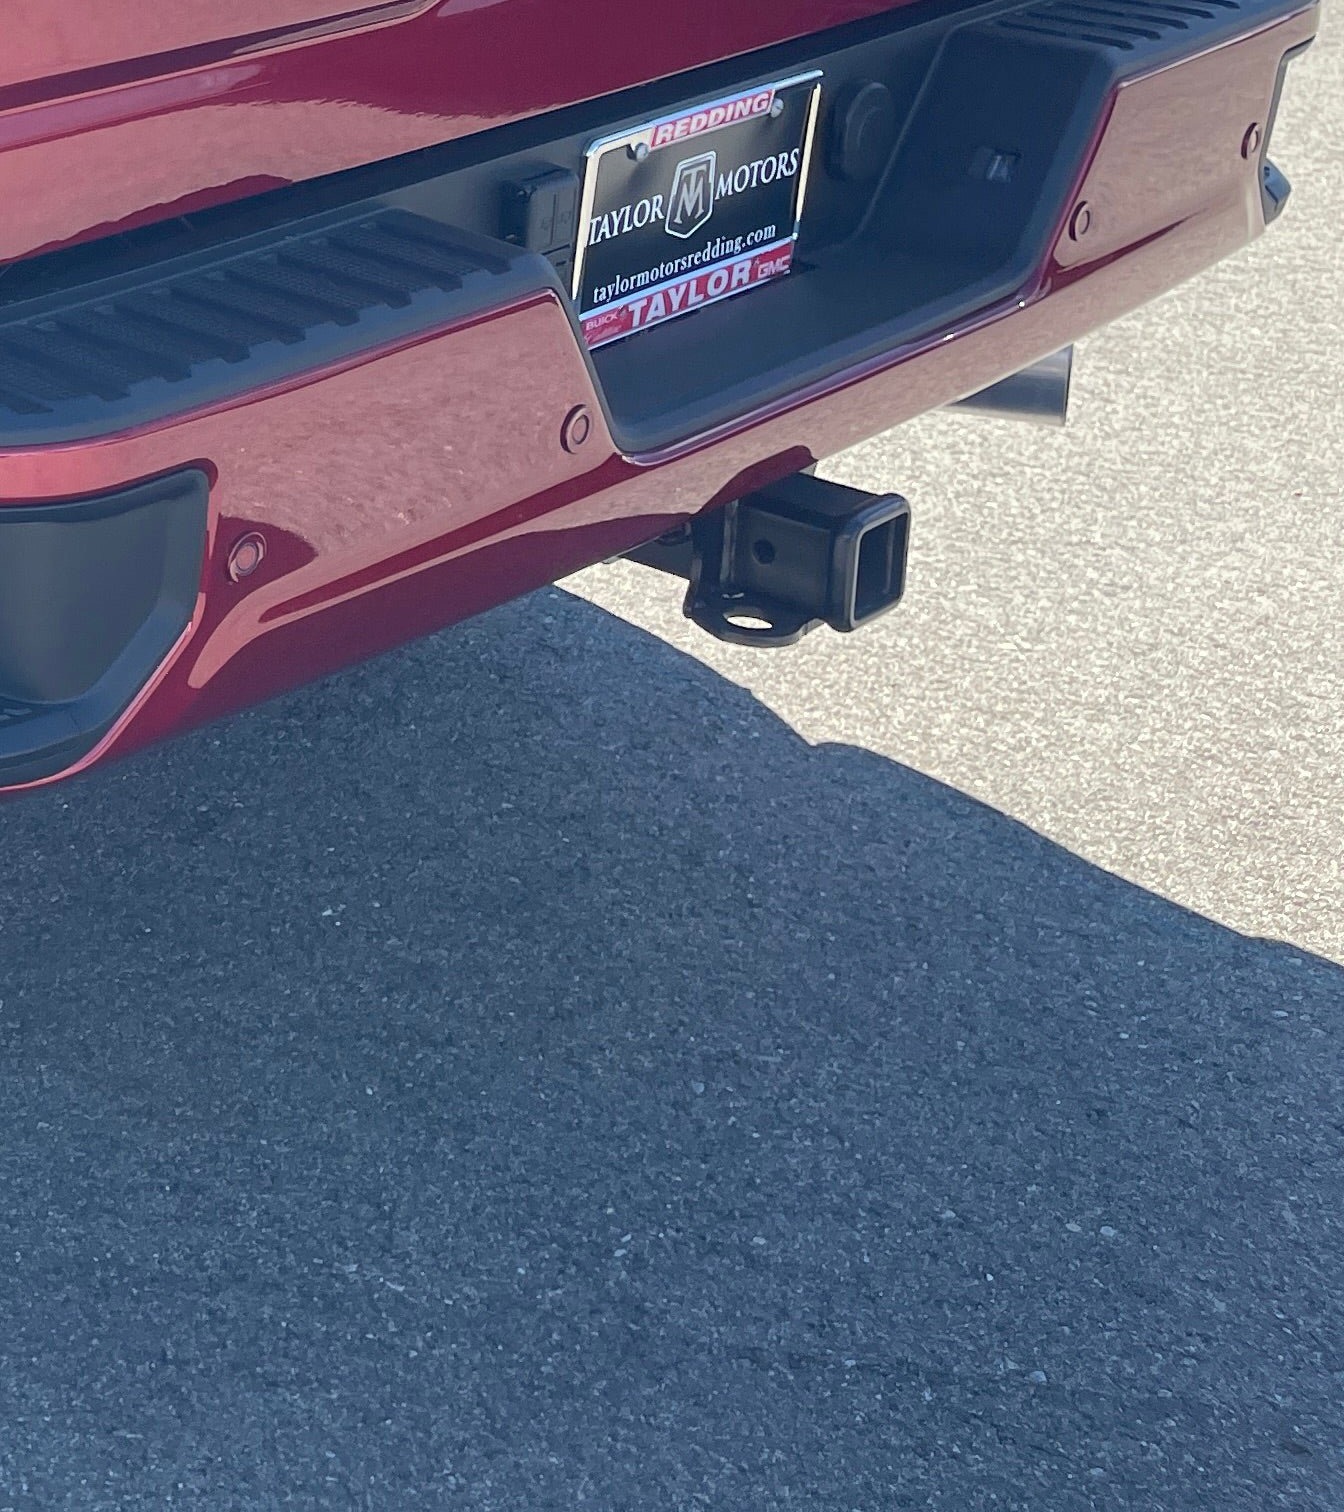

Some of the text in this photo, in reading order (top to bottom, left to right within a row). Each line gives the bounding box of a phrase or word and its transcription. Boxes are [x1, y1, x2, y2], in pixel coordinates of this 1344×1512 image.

[655, 93, 770, 145] REDDING
[587, 195, 664, 245] TAYLOR
[715, 147, 800, 201] MOTORS
[585, 254, 791, 331] BUICK TAYLOR GMC
[593, 223, 776, 303] taylormotorsredding.com
